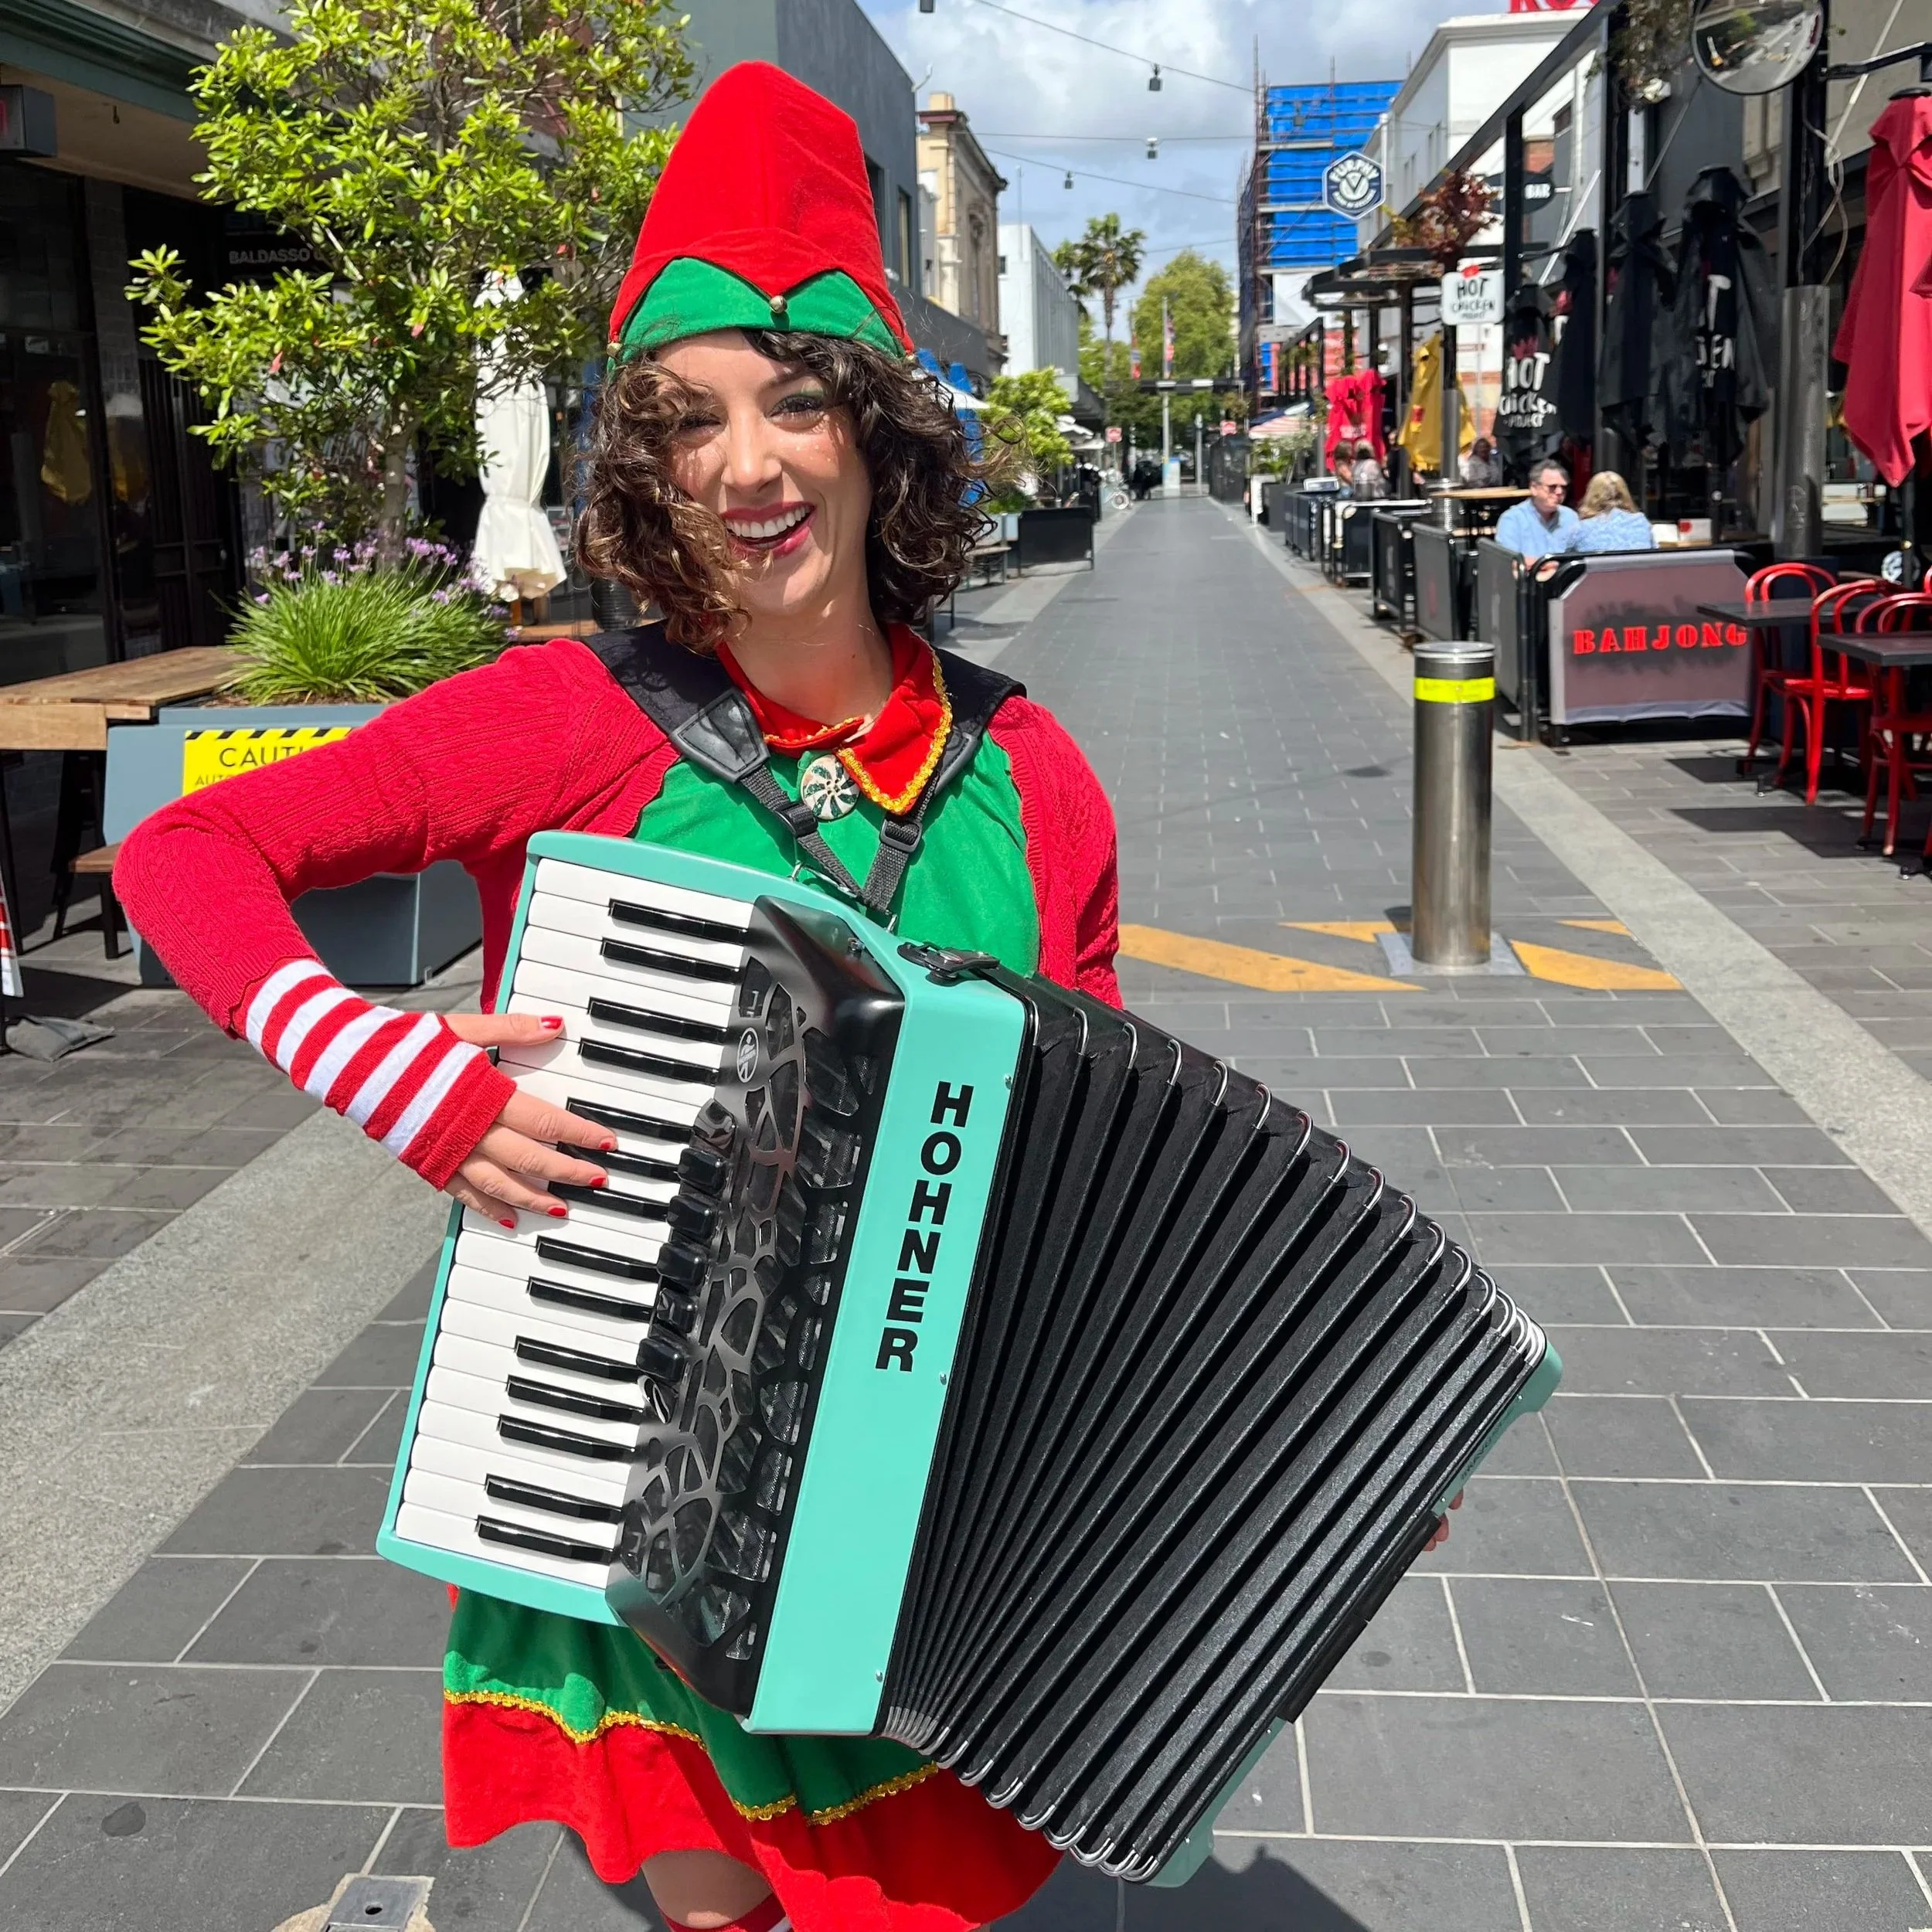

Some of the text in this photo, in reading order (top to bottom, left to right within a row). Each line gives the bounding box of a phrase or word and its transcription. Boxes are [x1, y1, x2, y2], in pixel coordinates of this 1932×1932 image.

[1525, 183, 1550, 199] BAR
[229, 248, 310, 264] BALDASSO
[1457, 278, 1490, 299] HOT
[1573, 621, 1747, 655] BAHJONG
[875, 1080, 975, 1372] HOHNER
